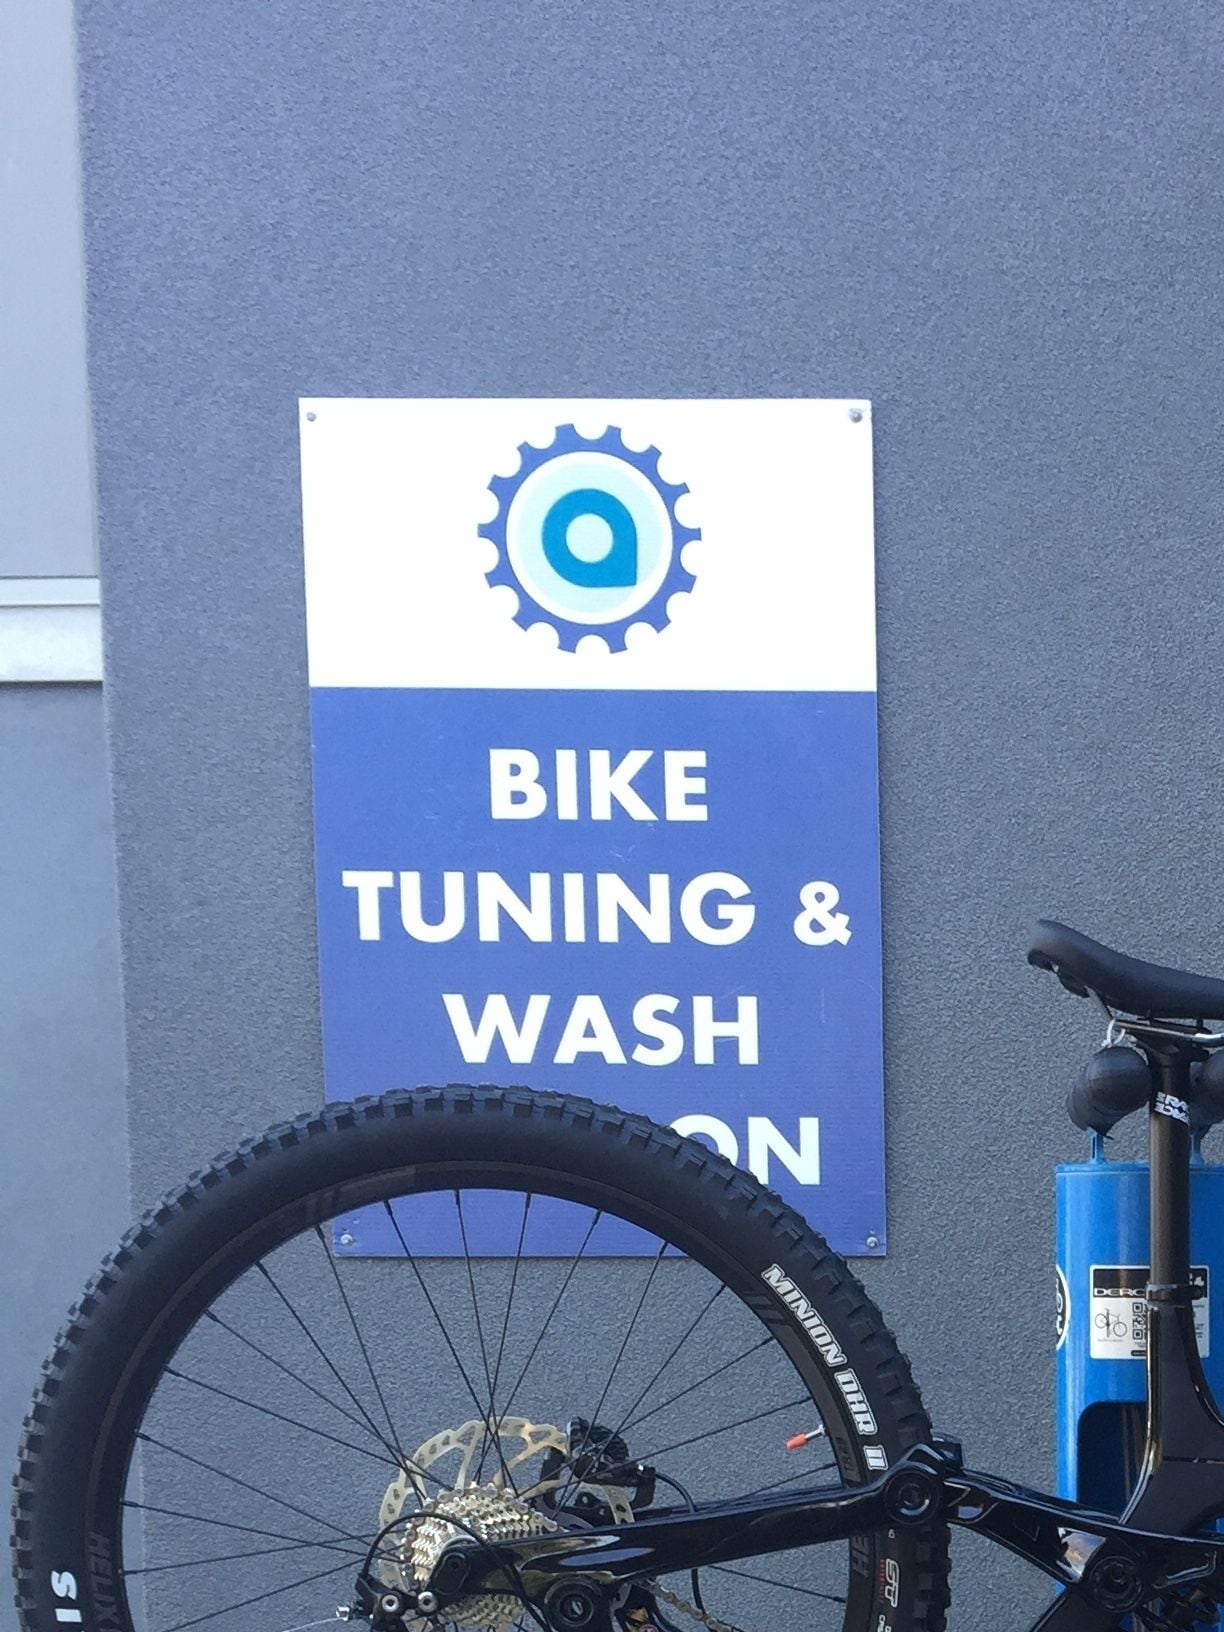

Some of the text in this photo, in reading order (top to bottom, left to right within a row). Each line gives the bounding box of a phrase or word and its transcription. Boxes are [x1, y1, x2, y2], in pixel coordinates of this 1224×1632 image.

[489, 748, 709, 822] BIKE
[342, 871, 853, 947] TUNING &
[442, 994, 760, 1066] WASH
[761, 1263, 847, 1368] MINION
[834, 1367, 879, 1437] DHR
[884, 1558, 900, 1608] ST
